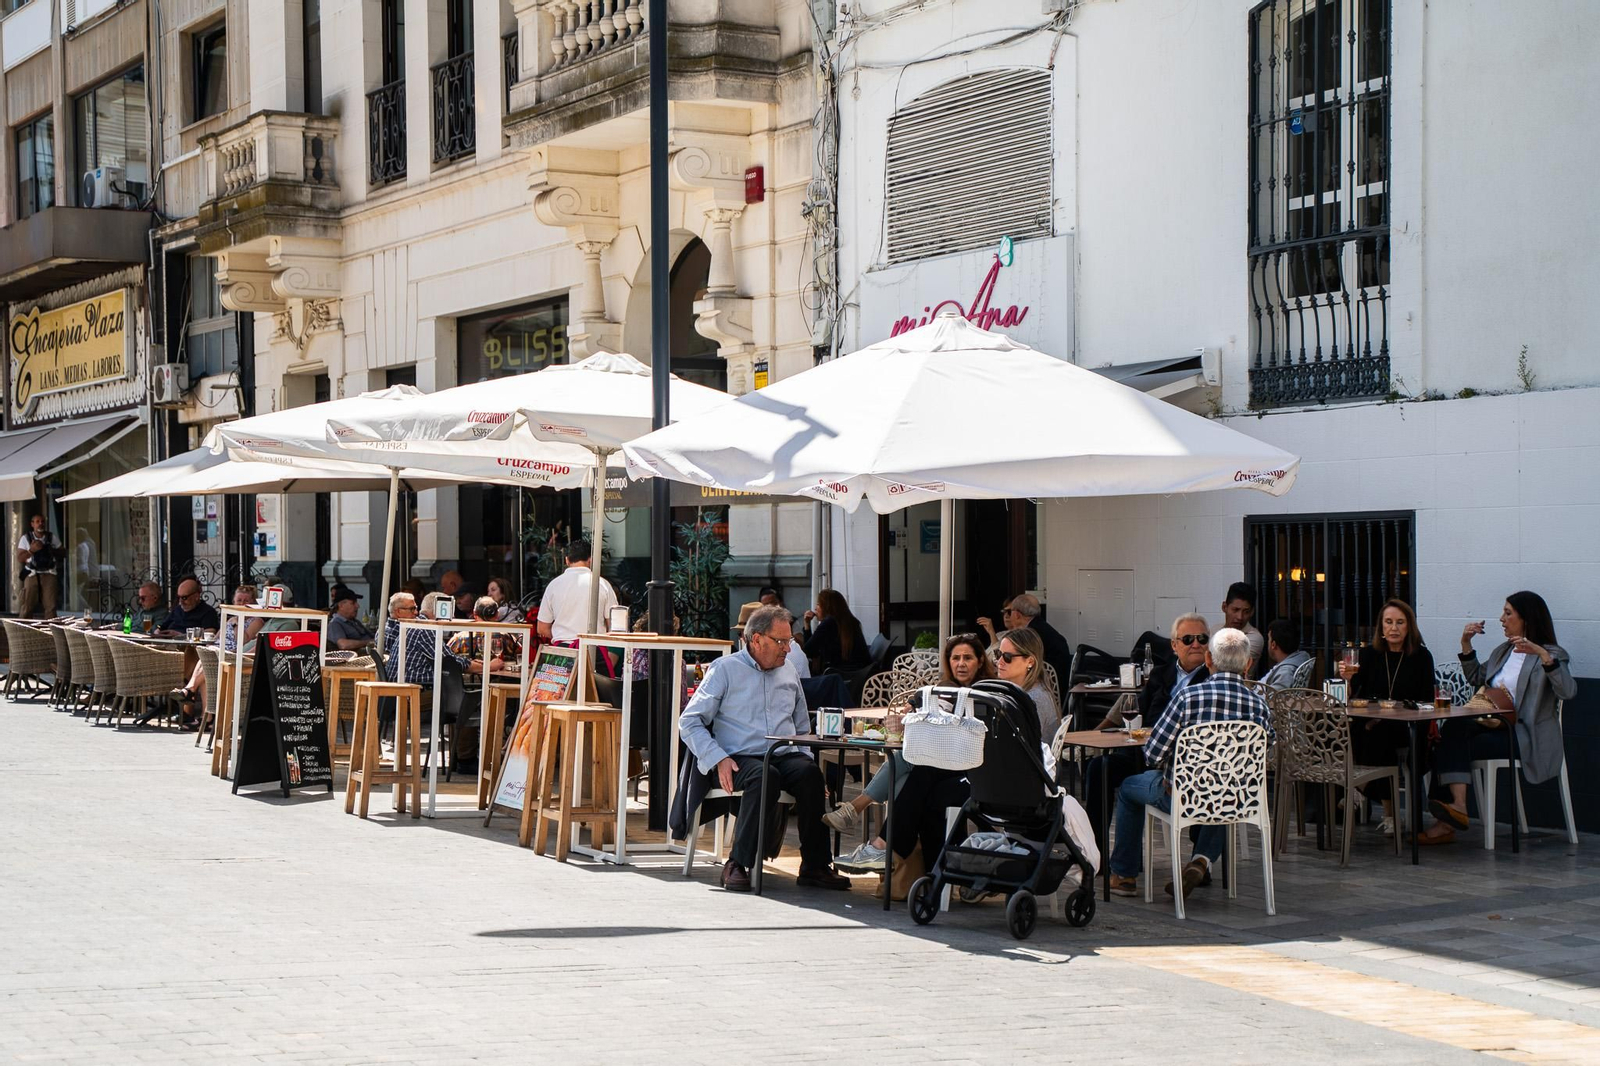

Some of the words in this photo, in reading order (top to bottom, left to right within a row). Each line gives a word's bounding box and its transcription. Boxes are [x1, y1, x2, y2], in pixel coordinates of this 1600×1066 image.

[83, 300, 124, 342] Plaza
[483, 324, 567, 370] BLISS
[510, 469, 551, 482] ESPECIAL
[271, 592, 279, 606] 3
[440, 602, 448, 618] 6
[1331, 685, 1345, 703] 10
[825, 714, 839, 735] 12
